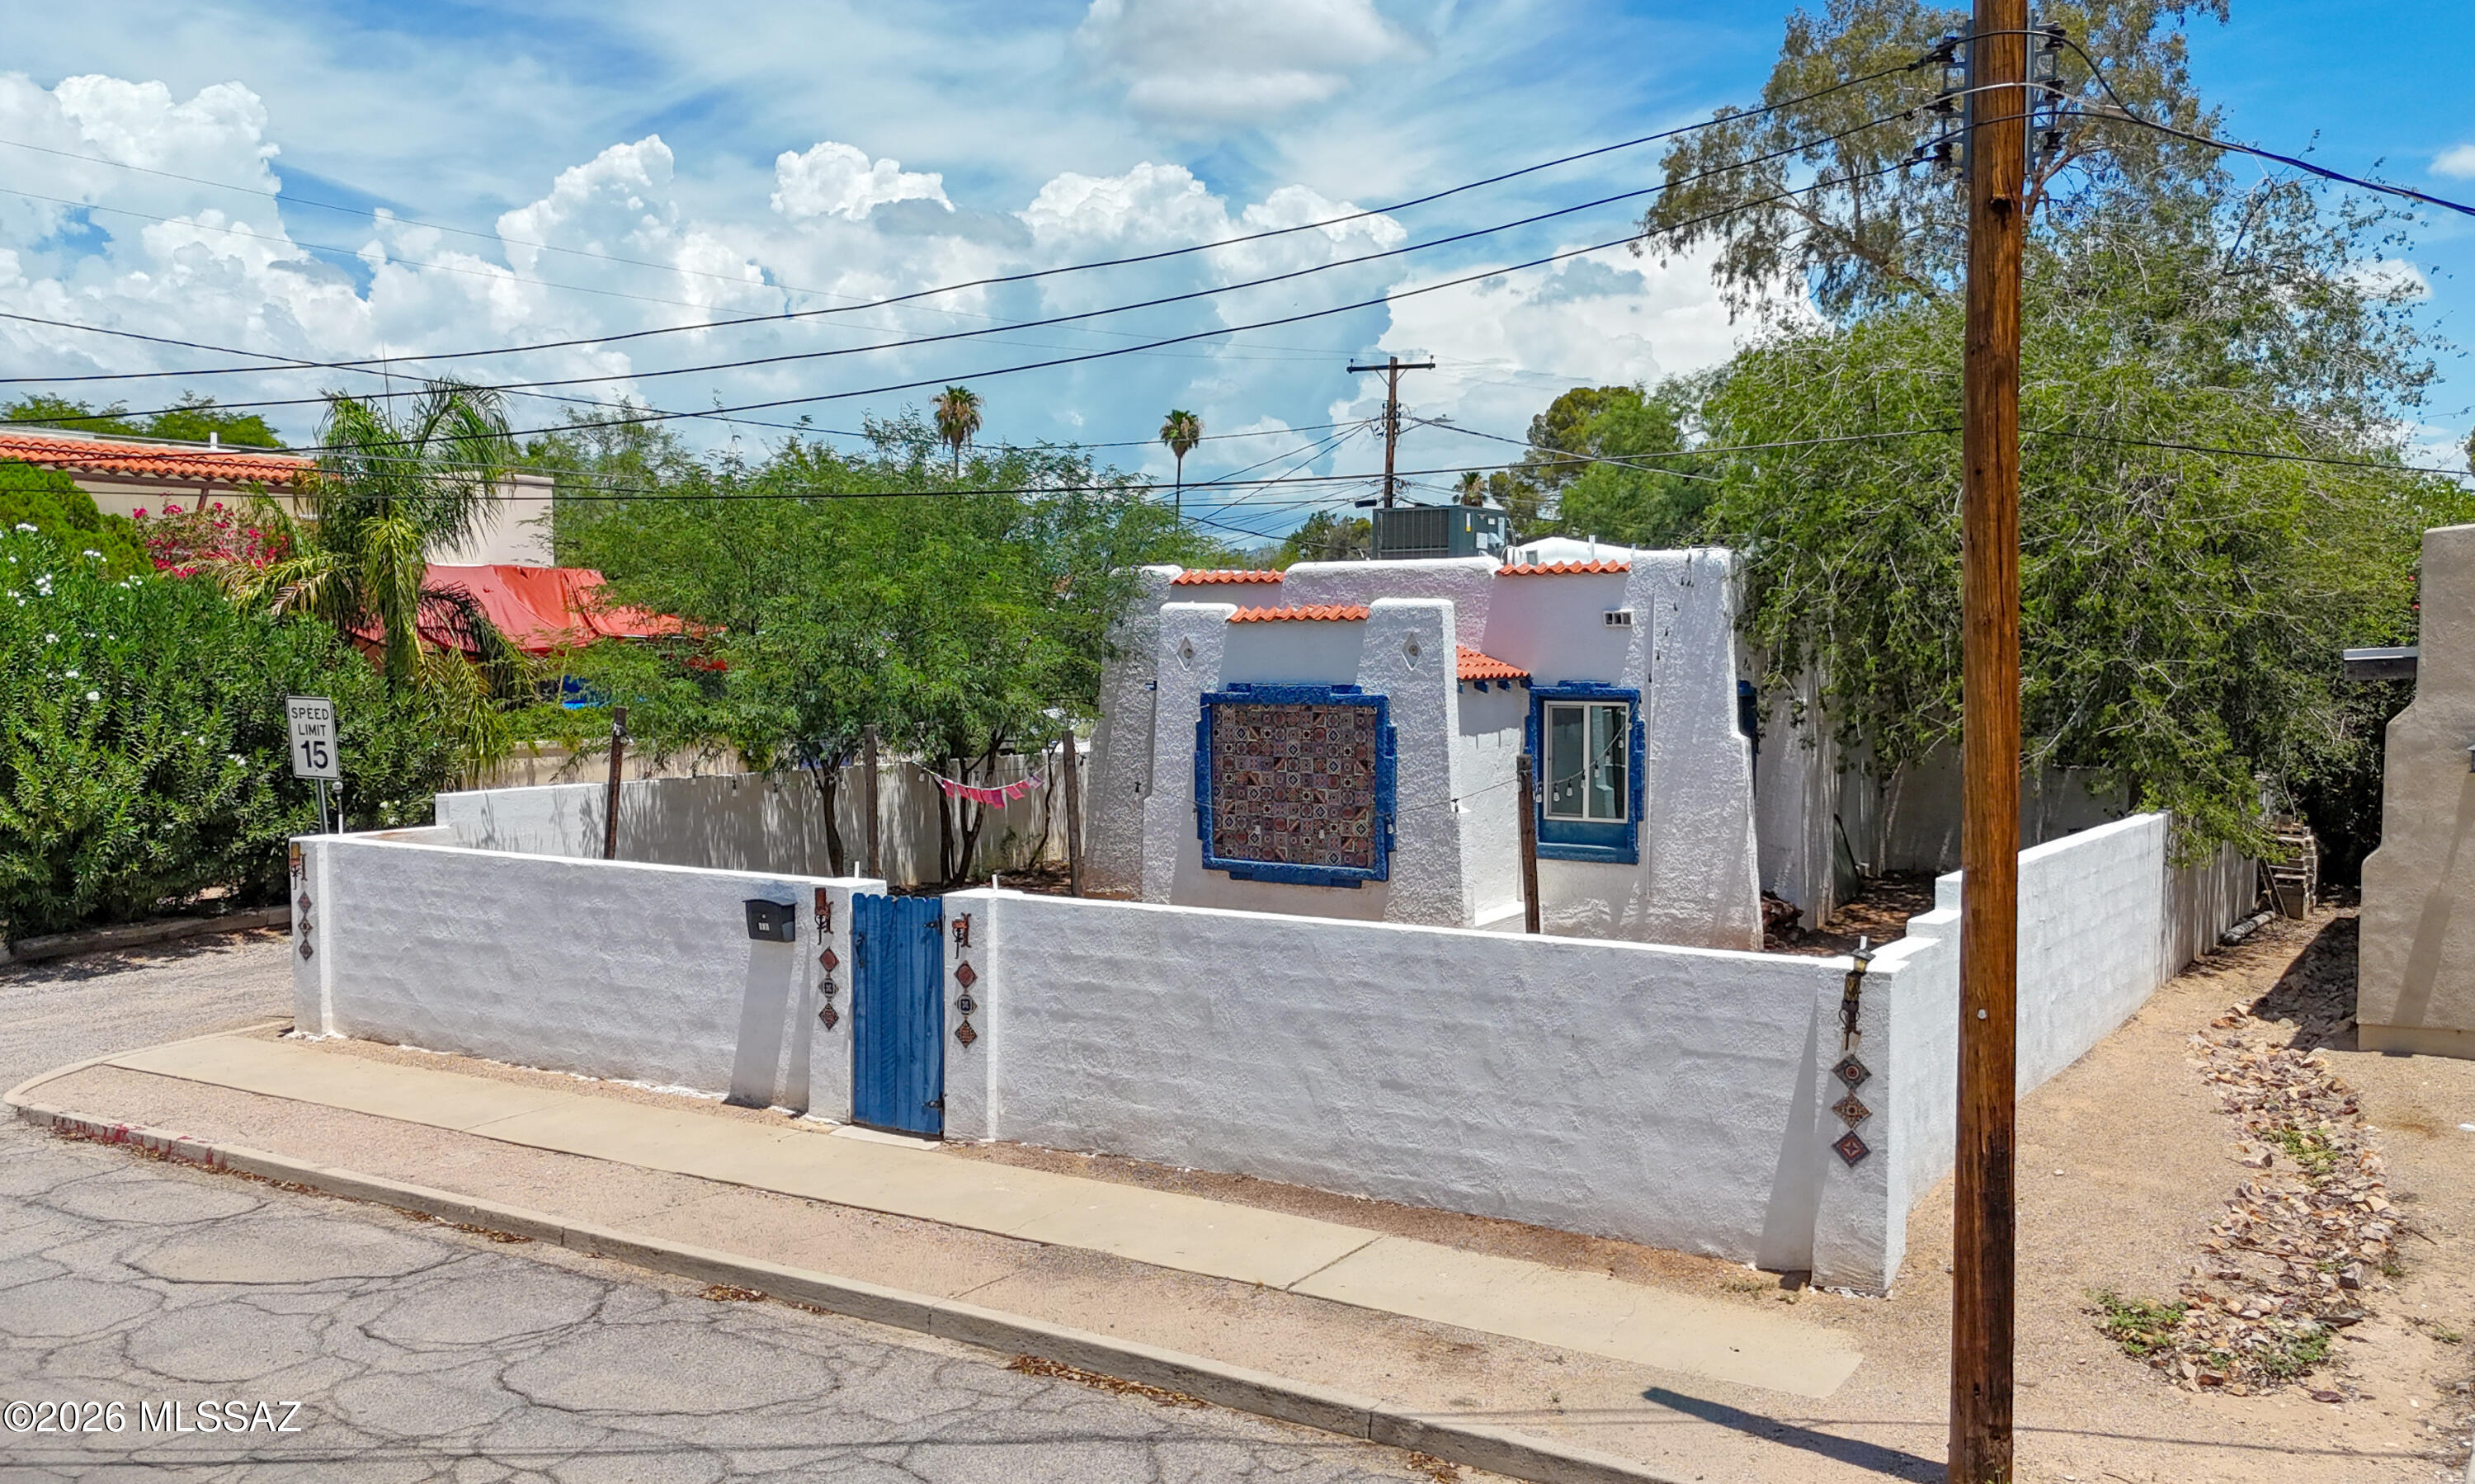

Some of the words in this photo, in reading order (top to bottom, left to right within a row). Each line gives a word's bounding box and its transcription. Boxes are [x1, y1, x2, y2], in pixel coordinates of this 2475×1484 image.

[291, 707, 329, 720] SPEED
[298, 723, 326, 737] LIMIT
[300, 740, 328, 769] 15
